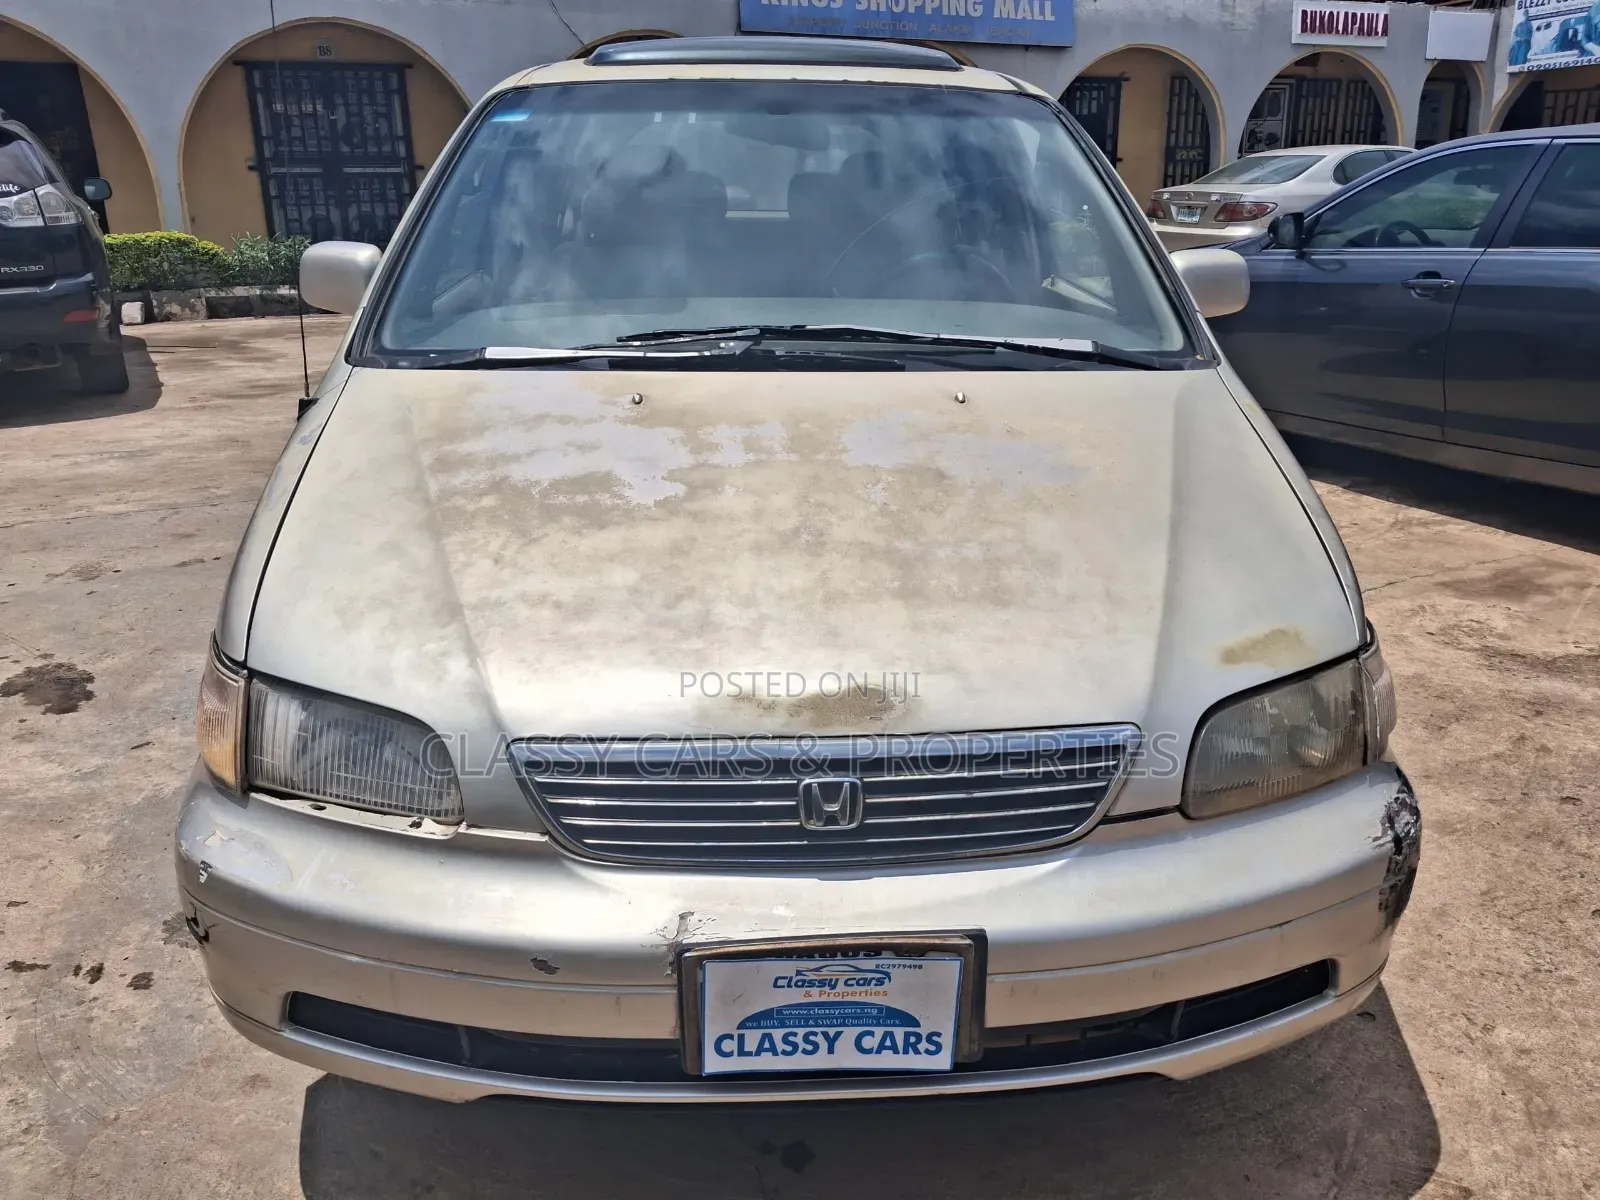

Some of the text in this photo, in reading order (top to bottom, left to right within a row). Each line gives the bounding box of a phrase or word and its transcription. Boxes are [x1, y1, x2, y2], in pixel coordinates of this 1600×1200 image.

[993, 0, 1056, 21] MALL
[853, 18, 918, 31] JUNCTION
[1300, 9, 1389, 37] BUKOLAPAULA
[1, 265, 44, 273] RX330
[773, 975, 887, 991] Classy cars
[803, 988, 888, 999] & Properties
[782, 1007, 878, 1016] www.classycars.ng
[785, 1018, 806, 1026] SELL
[845, 1017, 877, 1026] Quality
[713, 1029, 943, 1058] CLASSY CARS
